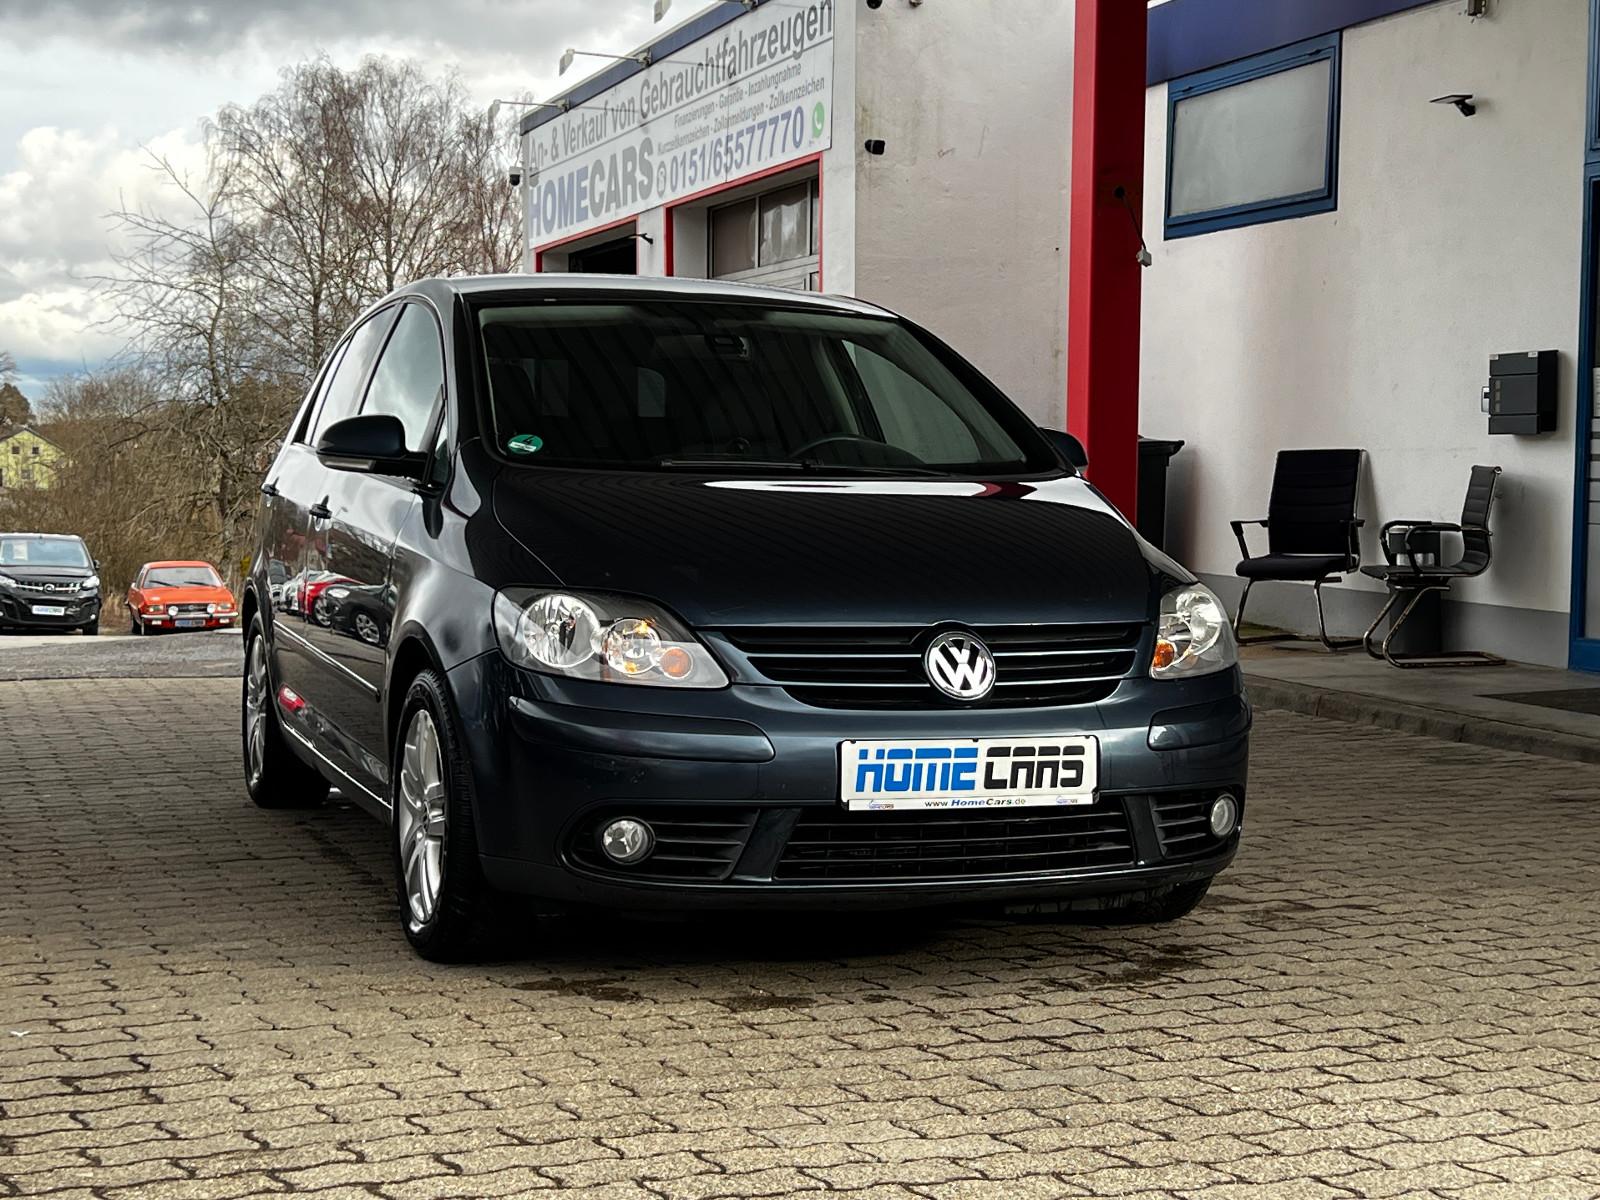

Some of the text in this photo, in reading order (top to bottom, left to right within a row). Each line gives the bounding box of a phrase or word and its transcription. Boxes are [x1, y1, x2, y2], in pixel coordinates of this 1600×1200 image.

[551, 126, 559, 162] &
[562, 99, 609, 157] Verkauf
[611, 96, 636, 134] von
[640, 0, 832, 120] Gebrauchtfahrzeugen
[669, 105, 805, 193] 0151/65577770
[855, 747, 979, 793] HOME
